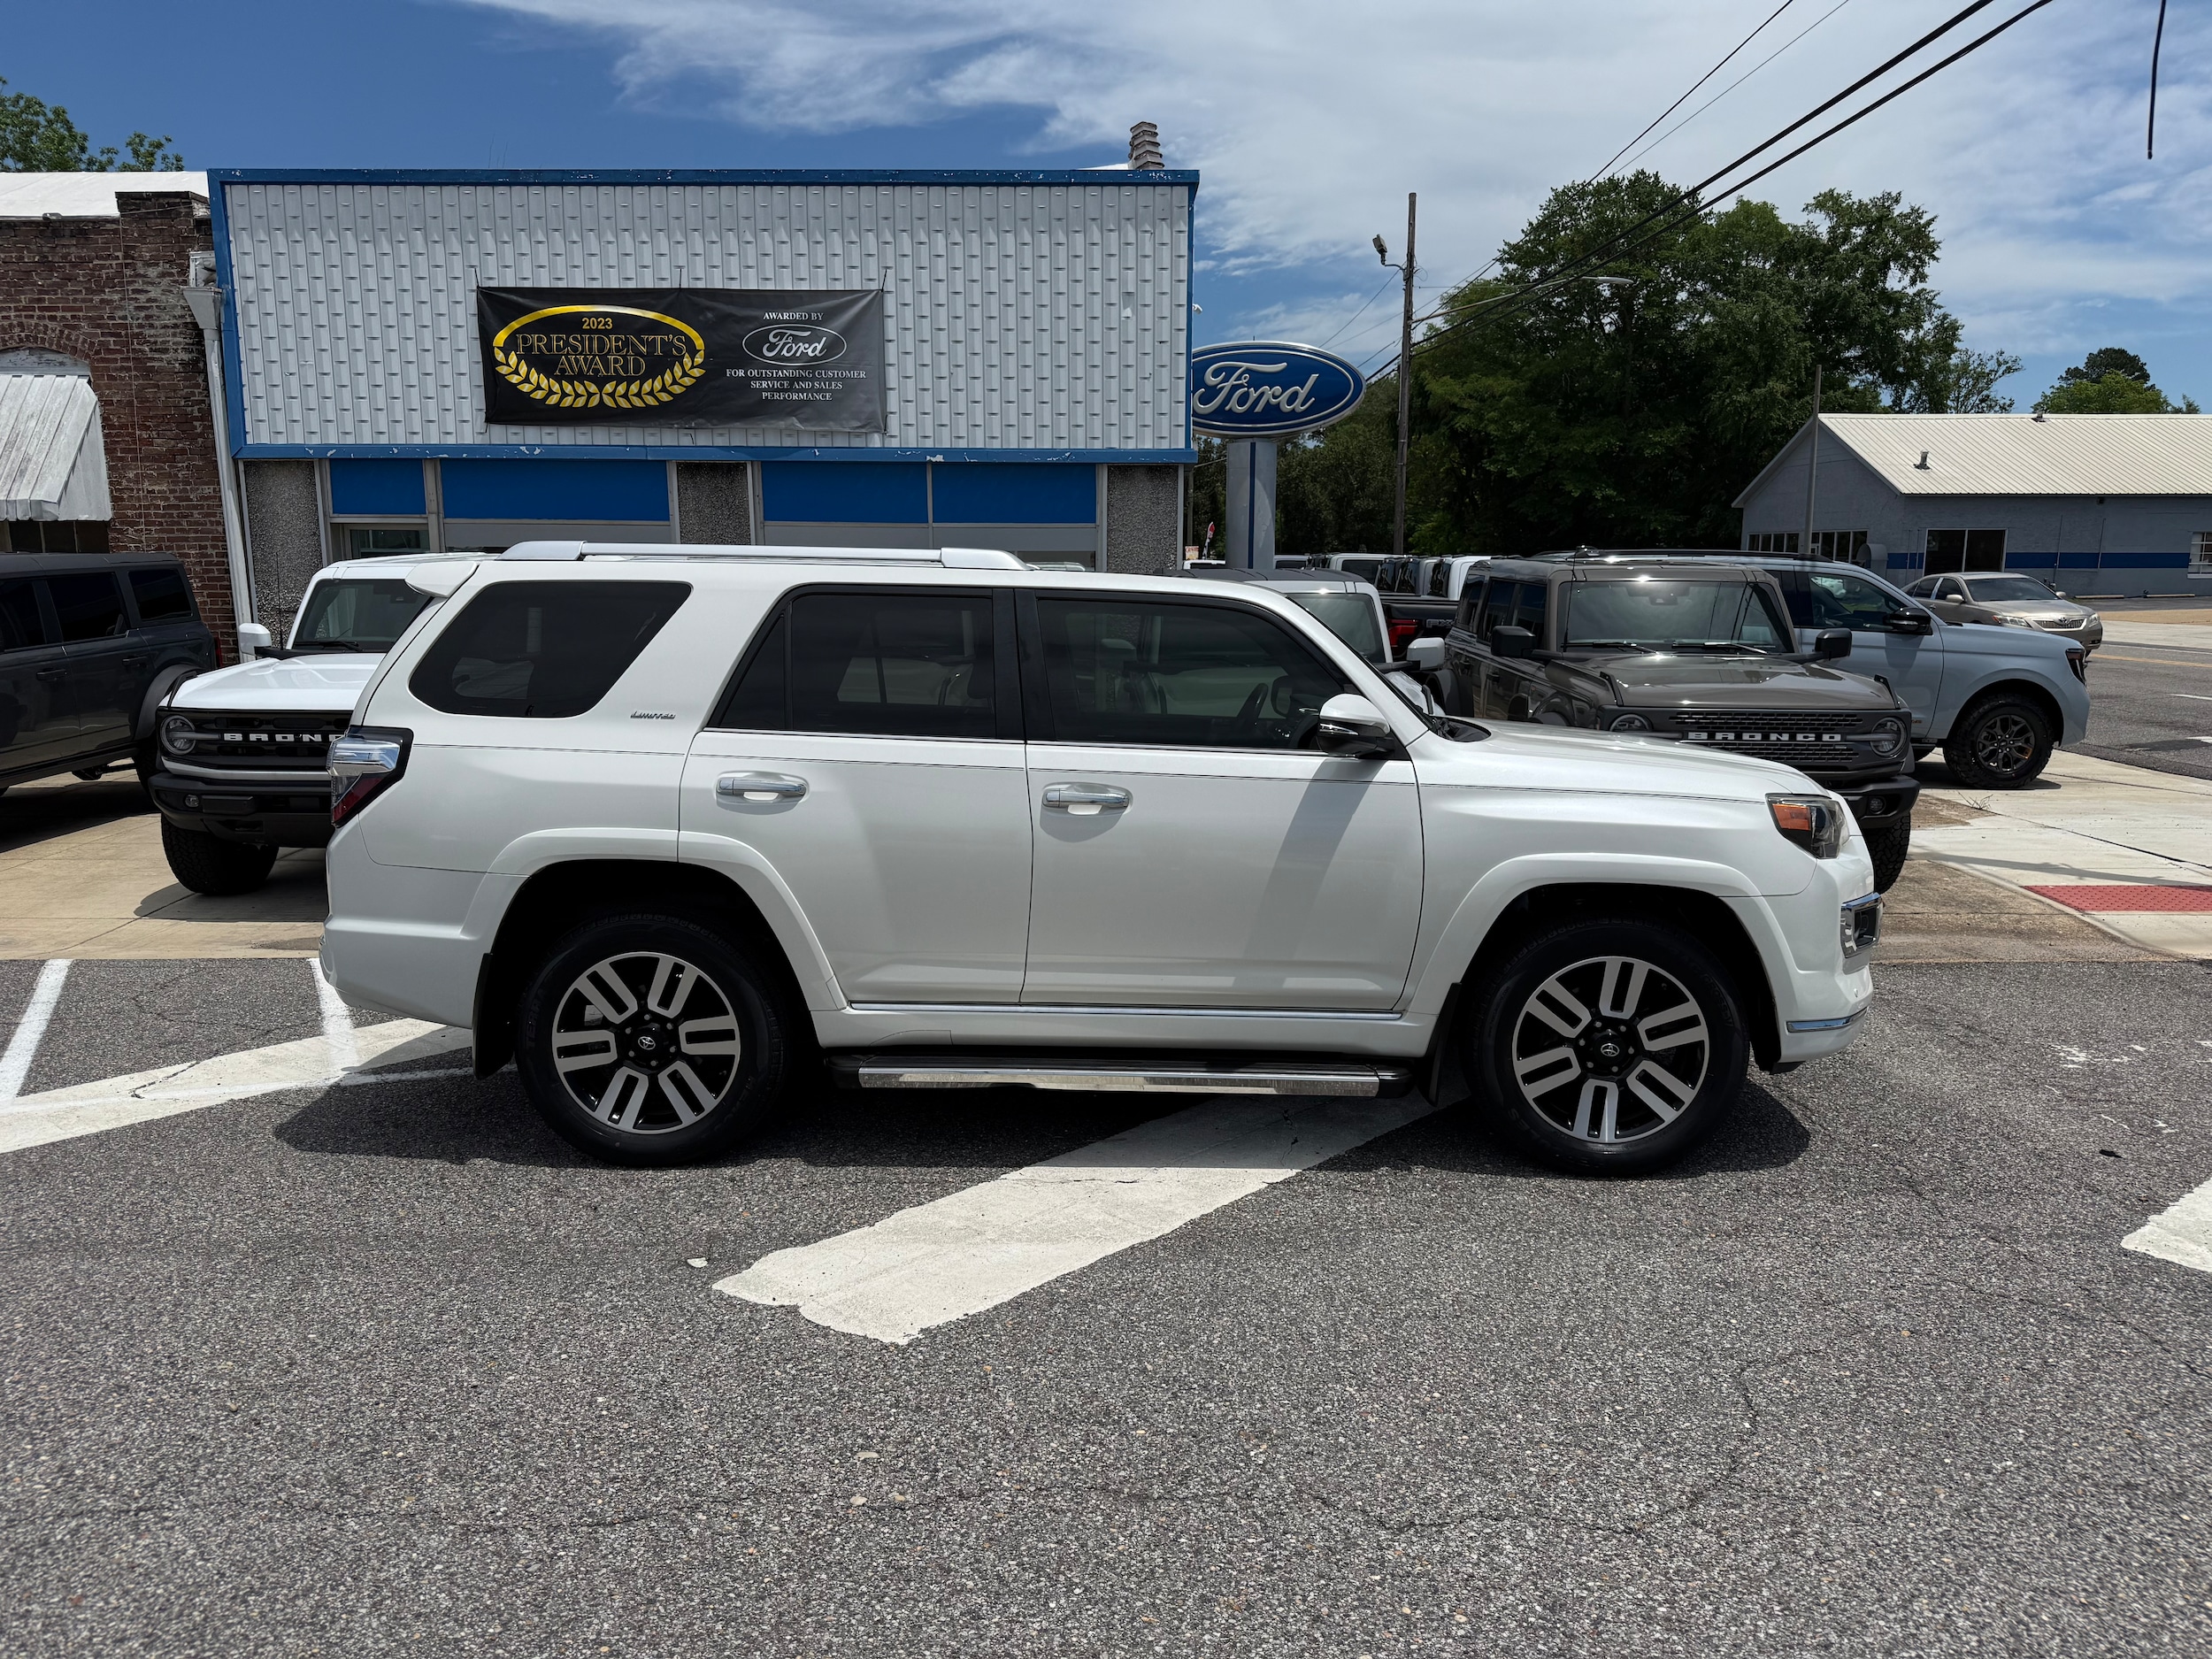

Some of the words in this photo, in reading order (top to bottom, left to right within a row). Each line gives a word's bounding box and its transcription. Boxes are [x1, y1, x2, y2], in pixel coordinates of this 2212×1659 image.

[581, 317, 613, 330] 2023
[517, 334, 687, 356] PRESIDENT'S
[762, 329, 827, 357] Ford
[554, 356, 646, 377] AWARD
[726, 368, 746, 378] FOR
[747, 369, 813, 378] OUTSTANDING
[815, 370, 866, 380] CUSTOMER
[750, 380, 790, 389] SERVICE
[792, 380, 812, 389] AND
[813, 380, 843, 390] SALES
[1194, 361, 1319, 415] Ford
[762, 391, 833, 401] PERFORMANCE
[1425, 618, 1453, 629] FX
[1688, 732, 1841, 741] BRONCO
